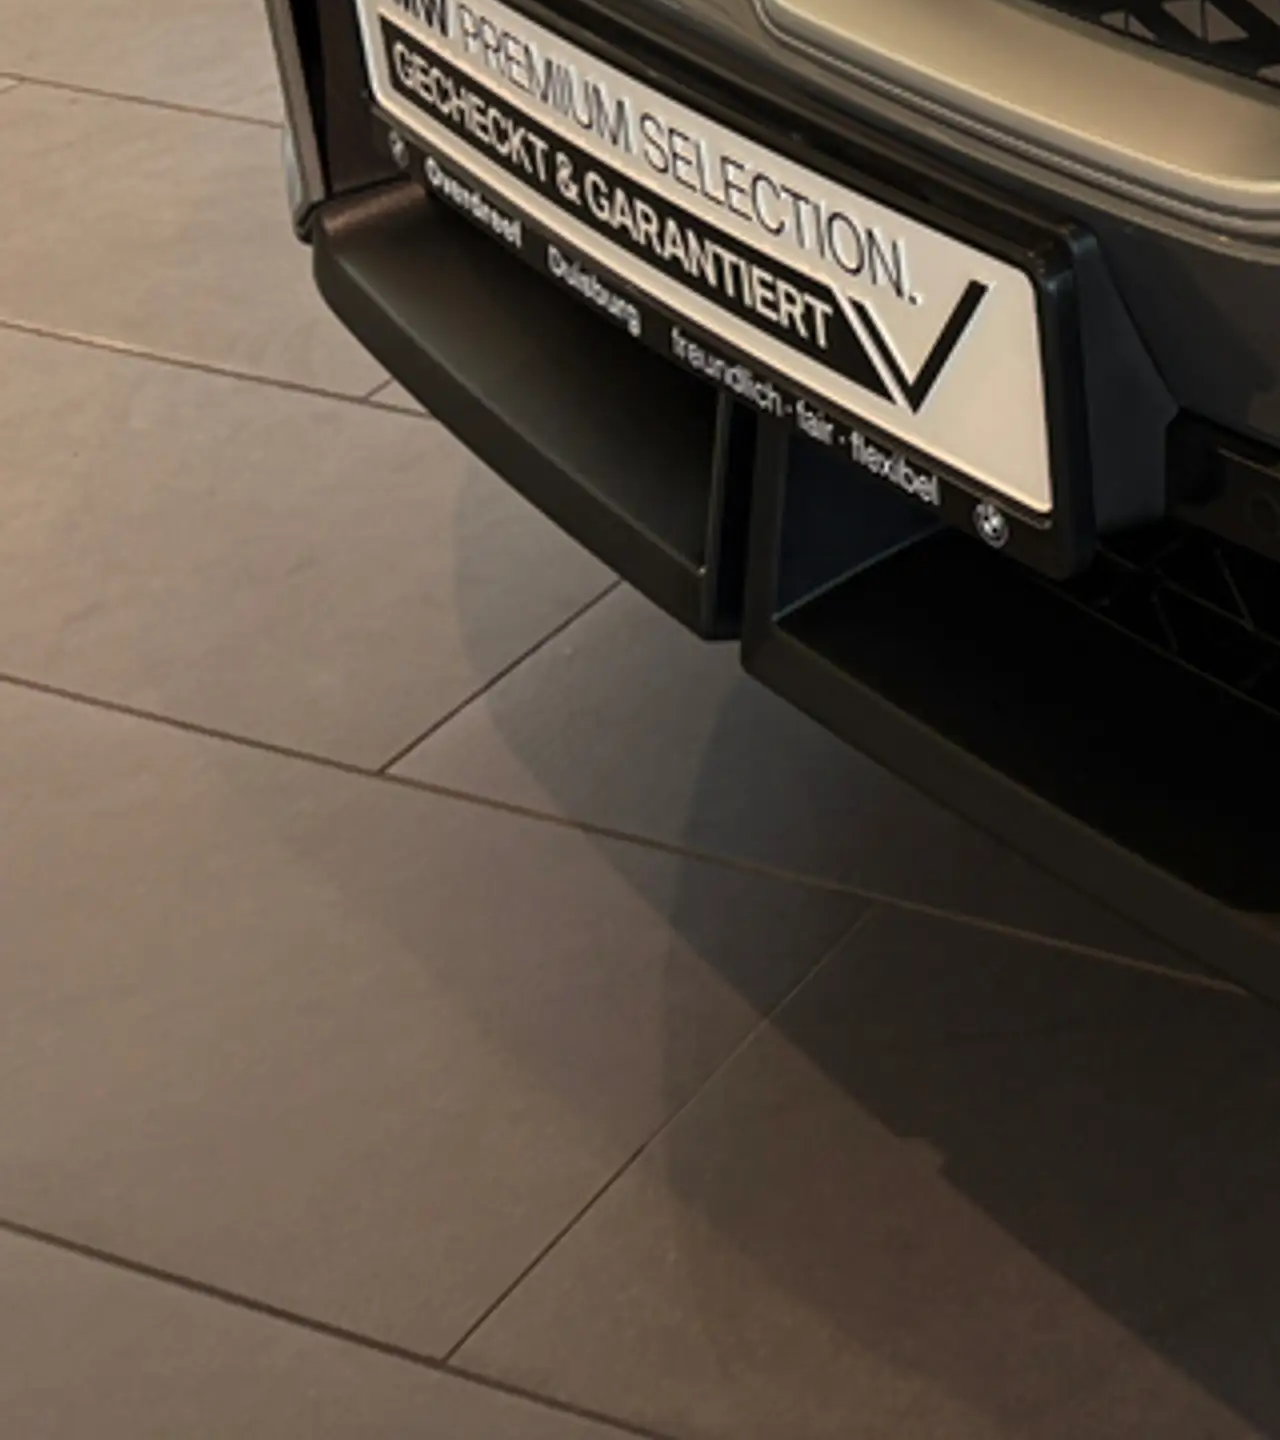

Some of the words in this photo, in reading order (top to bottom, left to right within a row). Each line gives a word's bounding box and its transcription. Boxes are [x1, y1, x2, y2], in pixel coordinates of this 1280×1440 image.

[392, 40, 549, 183] GECHECKT
[555, 150, 582, 206] &
[584, 169, 834, 350] GARANTIERT
[456, 3, 635, 154] PREMIUM
[639, 111, 922, 306] SELECTION.
[547, 243, 641, 338] Duisburg
[671, 324, 785, 417] freundlich
[795, 399, 834, 446] fair
[850, 430, 940, 506] flexibel
